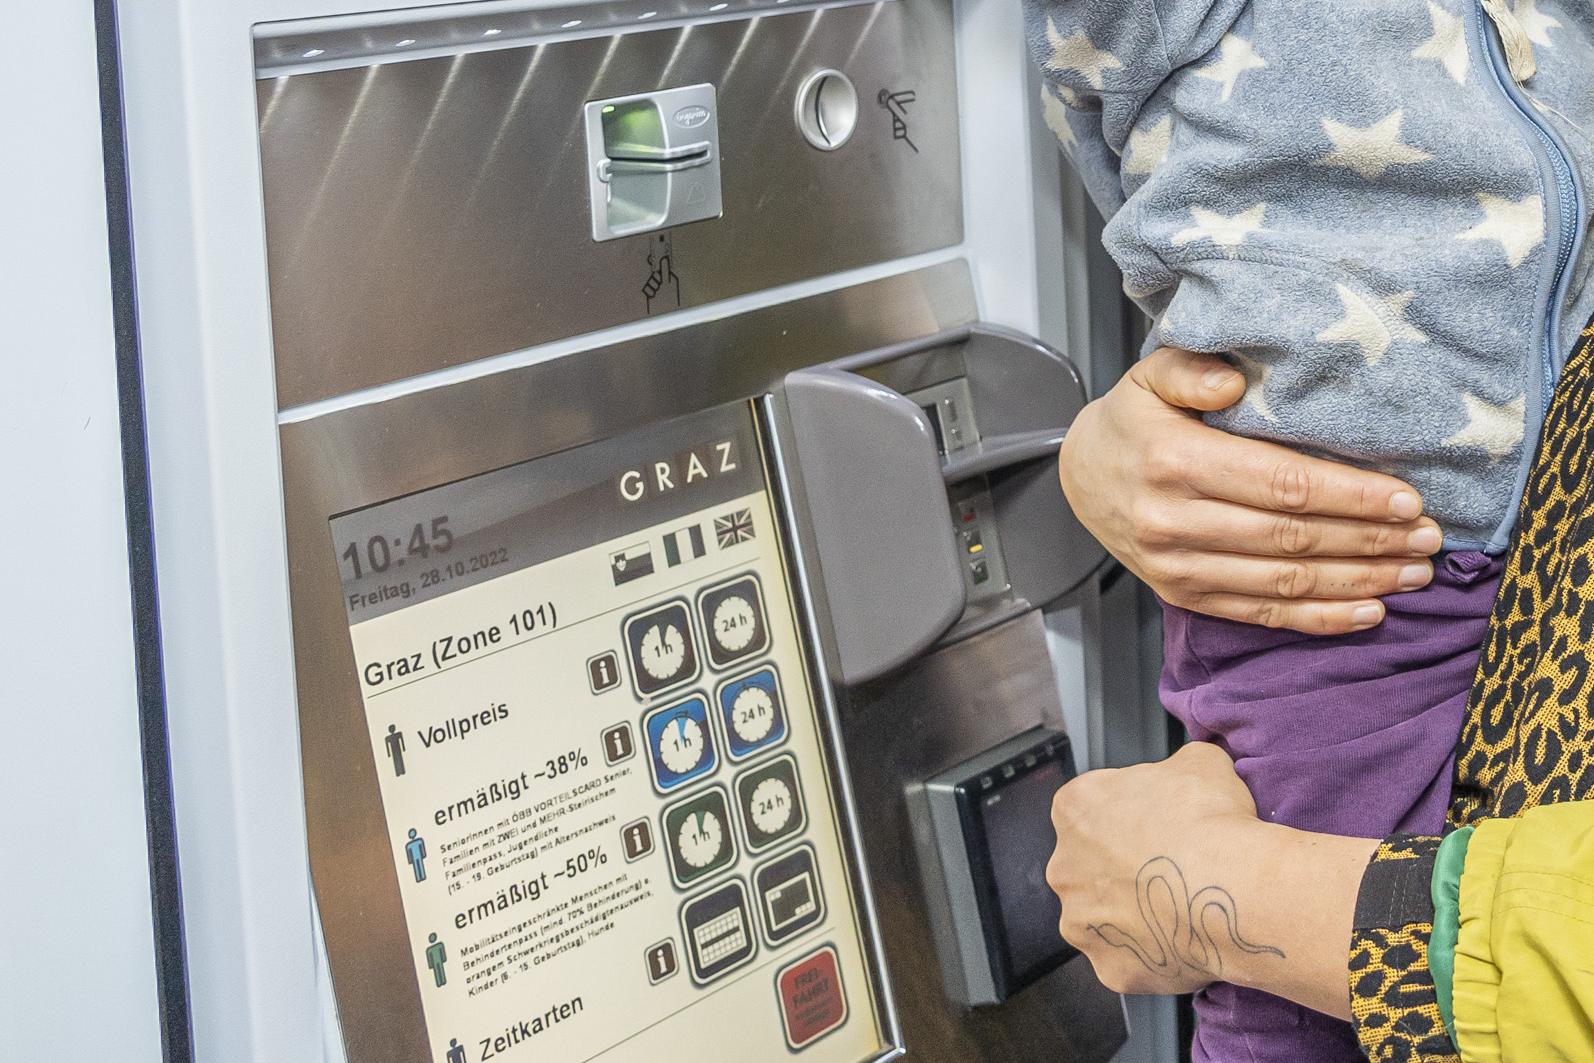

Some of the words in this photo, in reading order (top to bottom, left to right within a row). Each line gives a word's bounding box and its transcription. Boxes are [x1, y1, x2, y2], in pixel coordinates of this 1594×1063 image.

[619, 441, 737, 502] GRAZ
[342, 515, 454, 582] 10:45
[349, 579, 416, 612] Freitag,
[420, 546, 509, 589] 28.10.2022
[363, 651, 426, 688] Graz
[431, 620, 502, 670] (Zone
[509, 601, 559, 638] 101)
[654, 645, 662, 658] 1
[722, 616, 737, 633] 24
[739, 613, 748, 627] h
[417, 702, 509, 749] Vollpreis
[673, 739, 680, 752] 1
[741, 708, 755, 724] 24
[757, 704, 766, 718] h
[433, 771, 530, 826] ermäßigt
[533, 748, 588, 780] ~38%
[497, 817, 510, 831] mit
[511, 809, 533, 823] ÖBB
[533, 778, 602, 813] VORTEILSCARD
[759, 799, 774, 816] 24
[776, 795, 784, 808] h
[442, 845, 481, 867] Familien
[482, 836, 496, 849] mit
[497, 829, 519, 844] ZWEI
[521, 821, 537, 834] und
[539, 787, 617, 825] MEHR-Steirischem
[445, 849, 506, 881] Familienpass,
[507, 825, 559, 853] Jugendliche
[447, 880, 465, 896] (15.
[471, 870, 485, 883] 19.
[487, 846, 539, 876] Geburtstag)
[540, 840, 554, 853] mit
[554, 813, 616, 847] Altersnachweis
[692, 833, 699, 846] 1
[454, 870, 550, 930] ermäßigt
[553, 845, 608, 880] ~50%
[460, 902, 569, 958] Mobilitätseingeschränkte
[571, 879, 614, 906] Menschen
[615, 872, 628, 885] mit
[462, 930, 538, 972] Behindertenpass
[540, 917, 566, 937] (mind.
[567, 907, 585, 922] 70%
[586, 879, 642, 912] Behinderung)
[466, 961, 505, 985] orangem
[468, 978, 500, 998] Kinder
[519, 961, 532, 973] 15.
[588, 921, 616, 939] Hunde
[479, 995, 584, 1062] Zeitkarten
